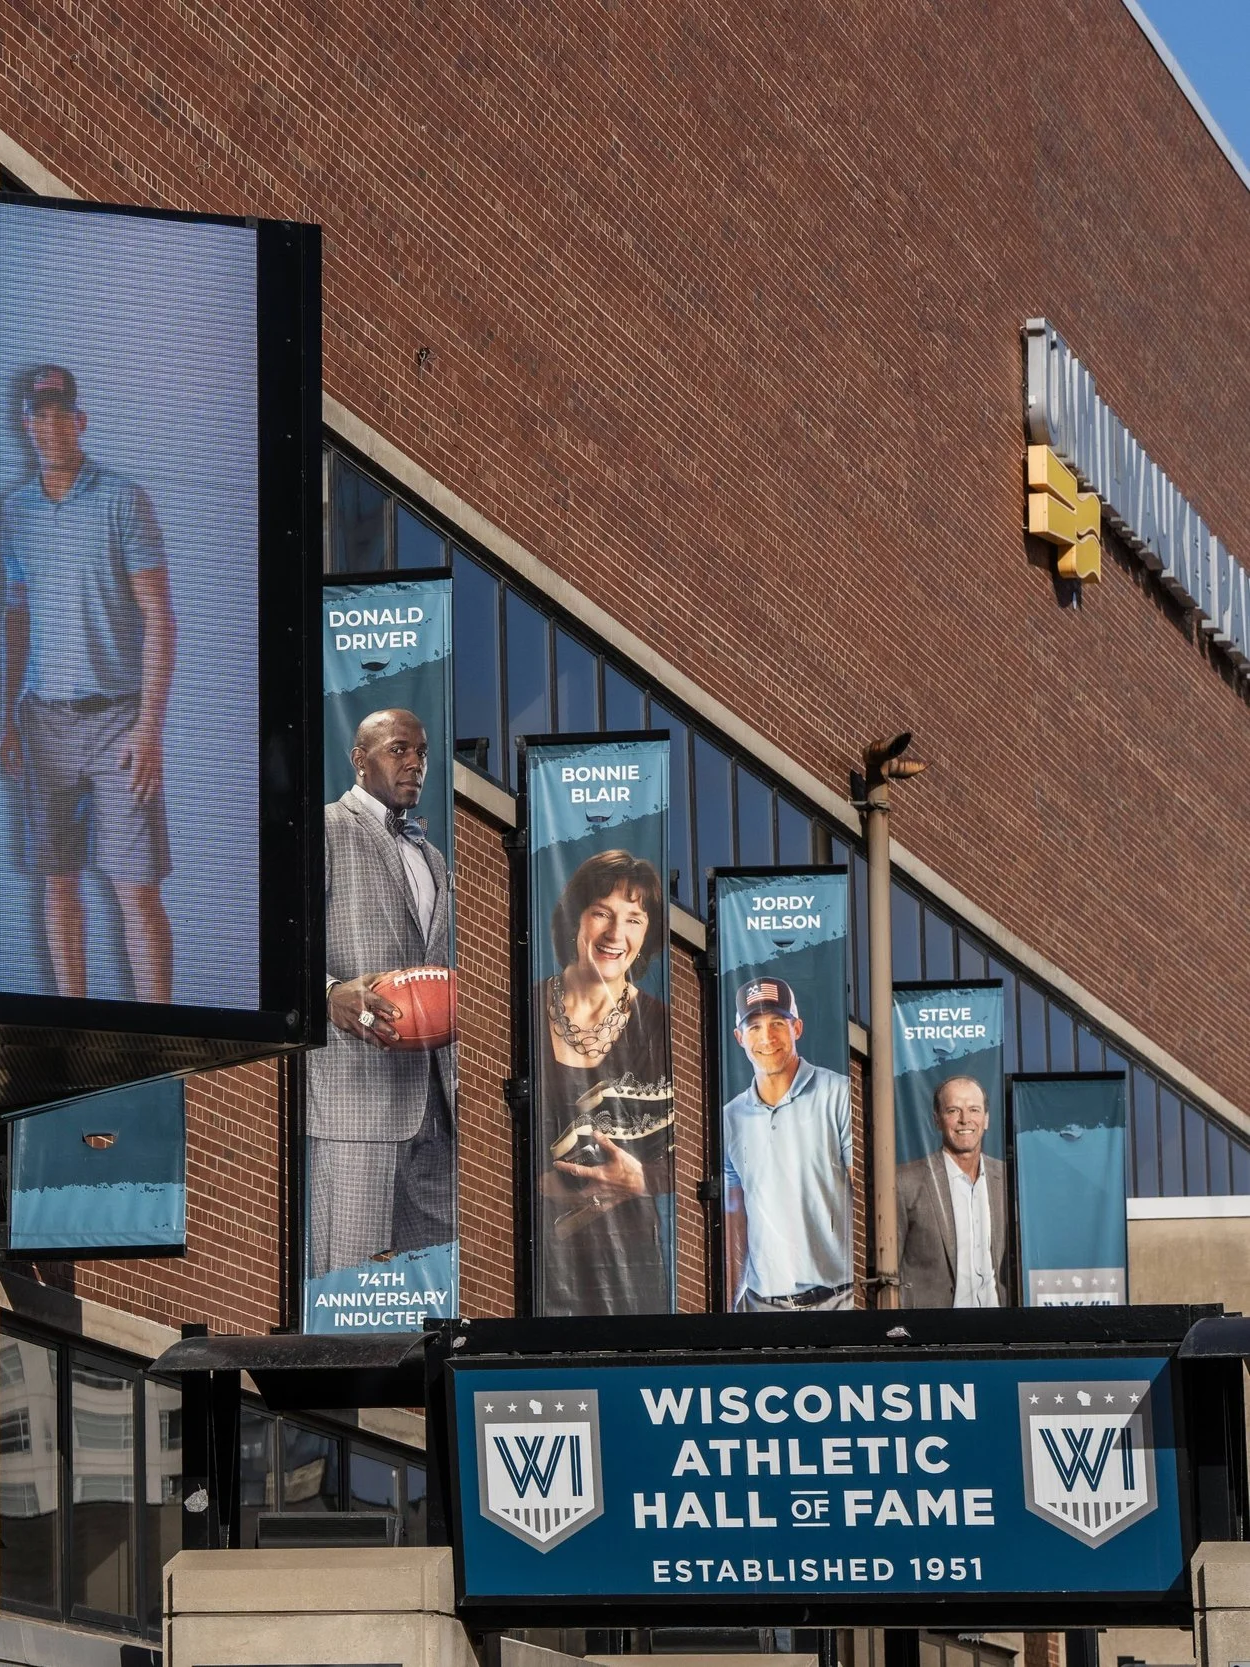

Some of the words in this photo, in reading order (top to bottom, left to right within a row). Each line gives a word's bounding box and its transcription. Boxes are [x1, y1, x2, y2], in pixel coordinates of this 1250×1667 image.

[330, 607, 423, 627] DONALD
[336, 631, 416, 650] DRIVER
[562, 765, 639, 782] BONNIE
[572, 787, 629, 802] BLAIR
[753, 896, 814, 910] JORDY
[747, 915, 820, 930] NELSON
[919, 1008, 971, 1021] STEVE
[903, 1025, 986, 1040] STRICKER
[358, 1273, 404, 1286] 74TH
[314, 1290, 448, 1307] ANNIVERSARY
[640, 1384, 975, 1424] WISCONSIN
[672, 1436, 950, 1476] ATHLETIC
[634, 1492, 777, 1528] HALL
[792, 1500, 829, 1519] OF
[844, 1489, 994, 1526] FAME
[653, 1559, 893, 1582] ESTABLISHED
[910, 1558, 981, 1580] 1951
